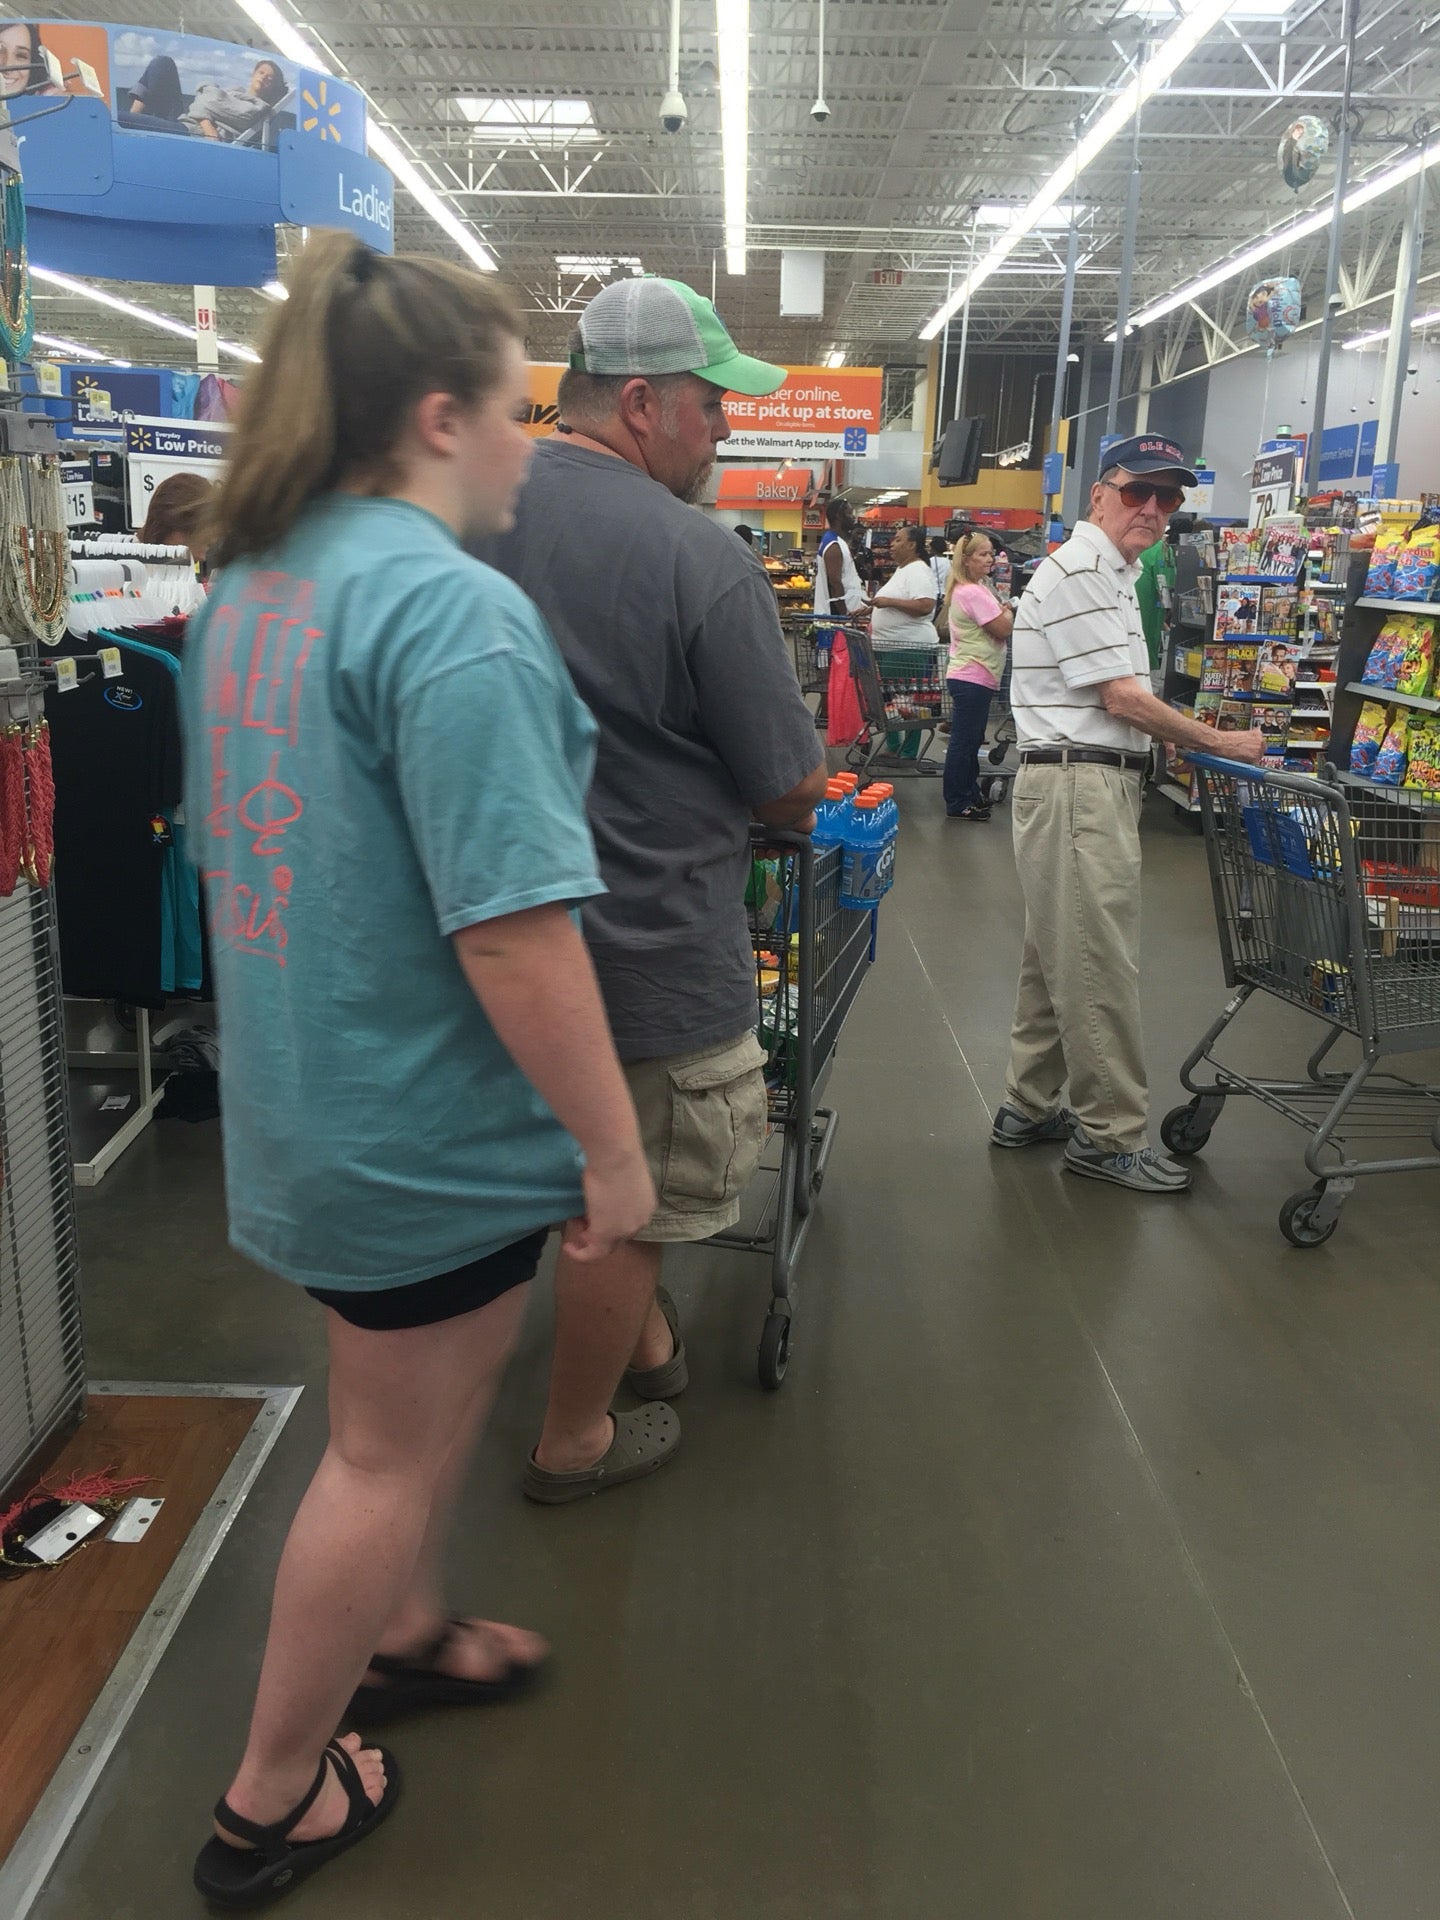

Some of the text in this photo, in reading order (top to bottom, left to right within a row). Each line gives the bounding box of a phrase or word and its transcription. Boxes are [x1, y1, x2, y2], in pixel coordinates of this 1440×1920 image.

[339, 172, 391, 231] Ladies
[795, 386, 842, 402] online.
[759, 402, 791, 421] pick
[792, 406, 813, 422] up
[815, 405, 831, 419] at
[833, 406, 874, 420] store.
[155, 431, 181, 440] Everyday
[724, 437, 842, 451] Get the Walmart App today.
[155, 437, 223, 455] Low Price
[1139, 441, 1163, 452] OLE
[1260, 465, 1284, 483] Low Price
[143, 474, 155, 493] $
[757, 481, 799, 502] Bakery
